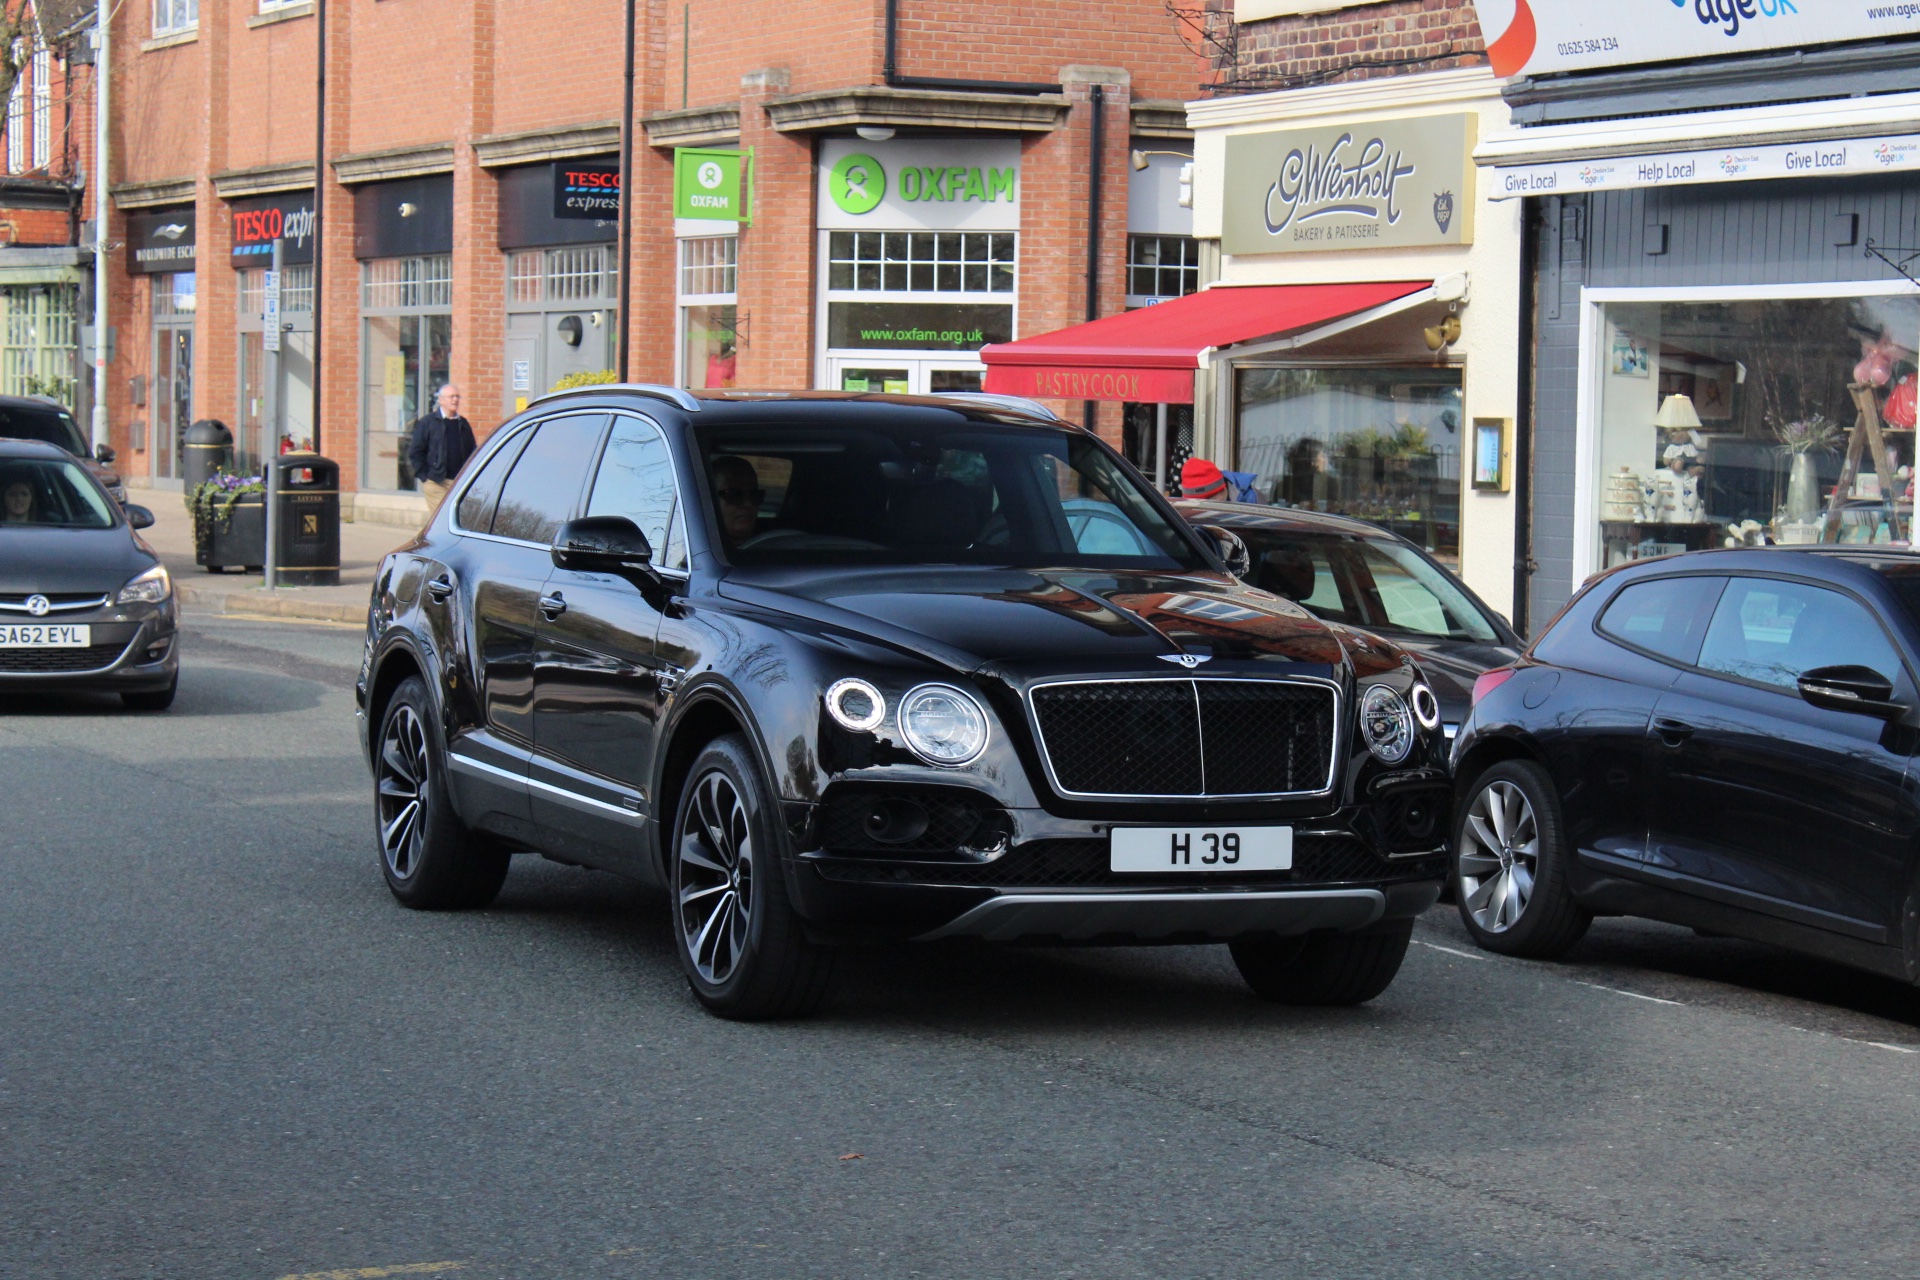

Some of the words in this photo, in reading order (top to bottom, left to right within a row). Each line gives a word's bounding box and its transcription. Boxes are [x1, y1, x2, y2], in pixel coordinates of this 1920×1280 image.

[1557, 40, 1584, 56] 01625
[1585, 38, 1601, 54] 584
[1602, 36, 1619, 52] 234
[1785, 152, 1812, 170] Give
[1815, 147, 1847, 168] Local
[1505, 175, 1528, 191] Give
[1530, 171, 1557, 190] Local
[1638, 163, 1663, 184] Help
[1666, 160, 1695, 179] Local
[899, 167, 1014, 203] OXFAM
[690, 195, 728, 209] OXFAM
[233, 207, 282, 241] TESCO
[1293, 226, 1323, 241] BAKERY
[1326, 226, 1333, 239] &
[1335, 223, 1380, 238] PATISSERIE
[860, 327, 983, 344] www.oxfam.org.uk
[1036, 371, 1140, 397] PASTRYCOOK
[48, 627, 82, 643] EYL
[1171, 833, 1190, 865] H
[1201, 832, 1240, 865] 39
